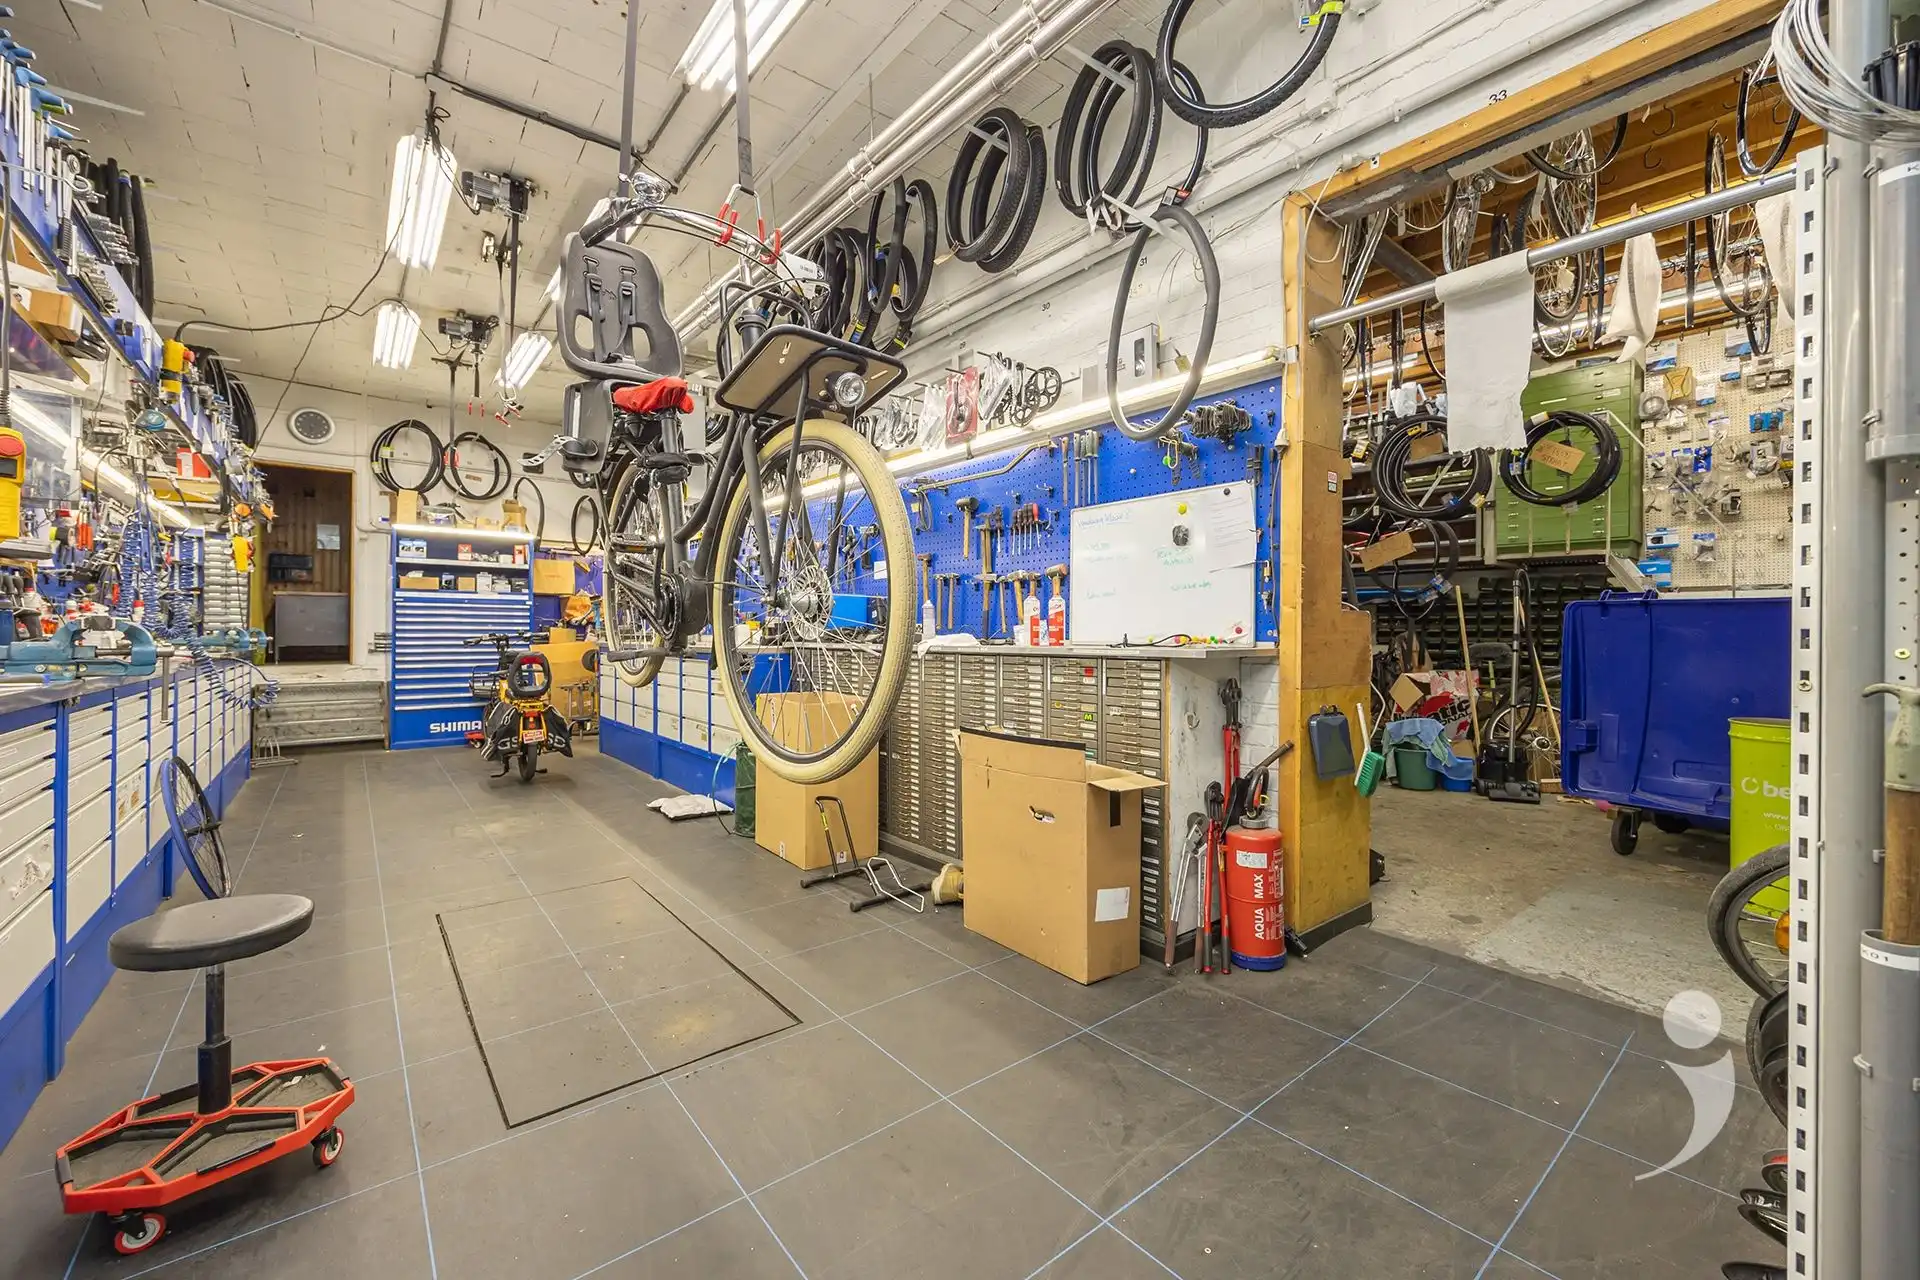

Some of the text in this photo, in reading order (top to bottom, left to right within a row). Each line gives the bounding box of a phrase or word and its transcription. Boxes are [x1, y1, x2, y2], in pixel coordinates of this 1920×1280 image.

[1488, 89, 1507, 106] 33
[1139, 256, 1148, 267] 31
[1041, 302, 1051, 312] 30
[429, 720, 483, 734] SHIMA
[1762, 780, 1790, 799] be
[1254, 873, 1264, 899] MAX
[1254, 907, 1265, 940] AQUA
